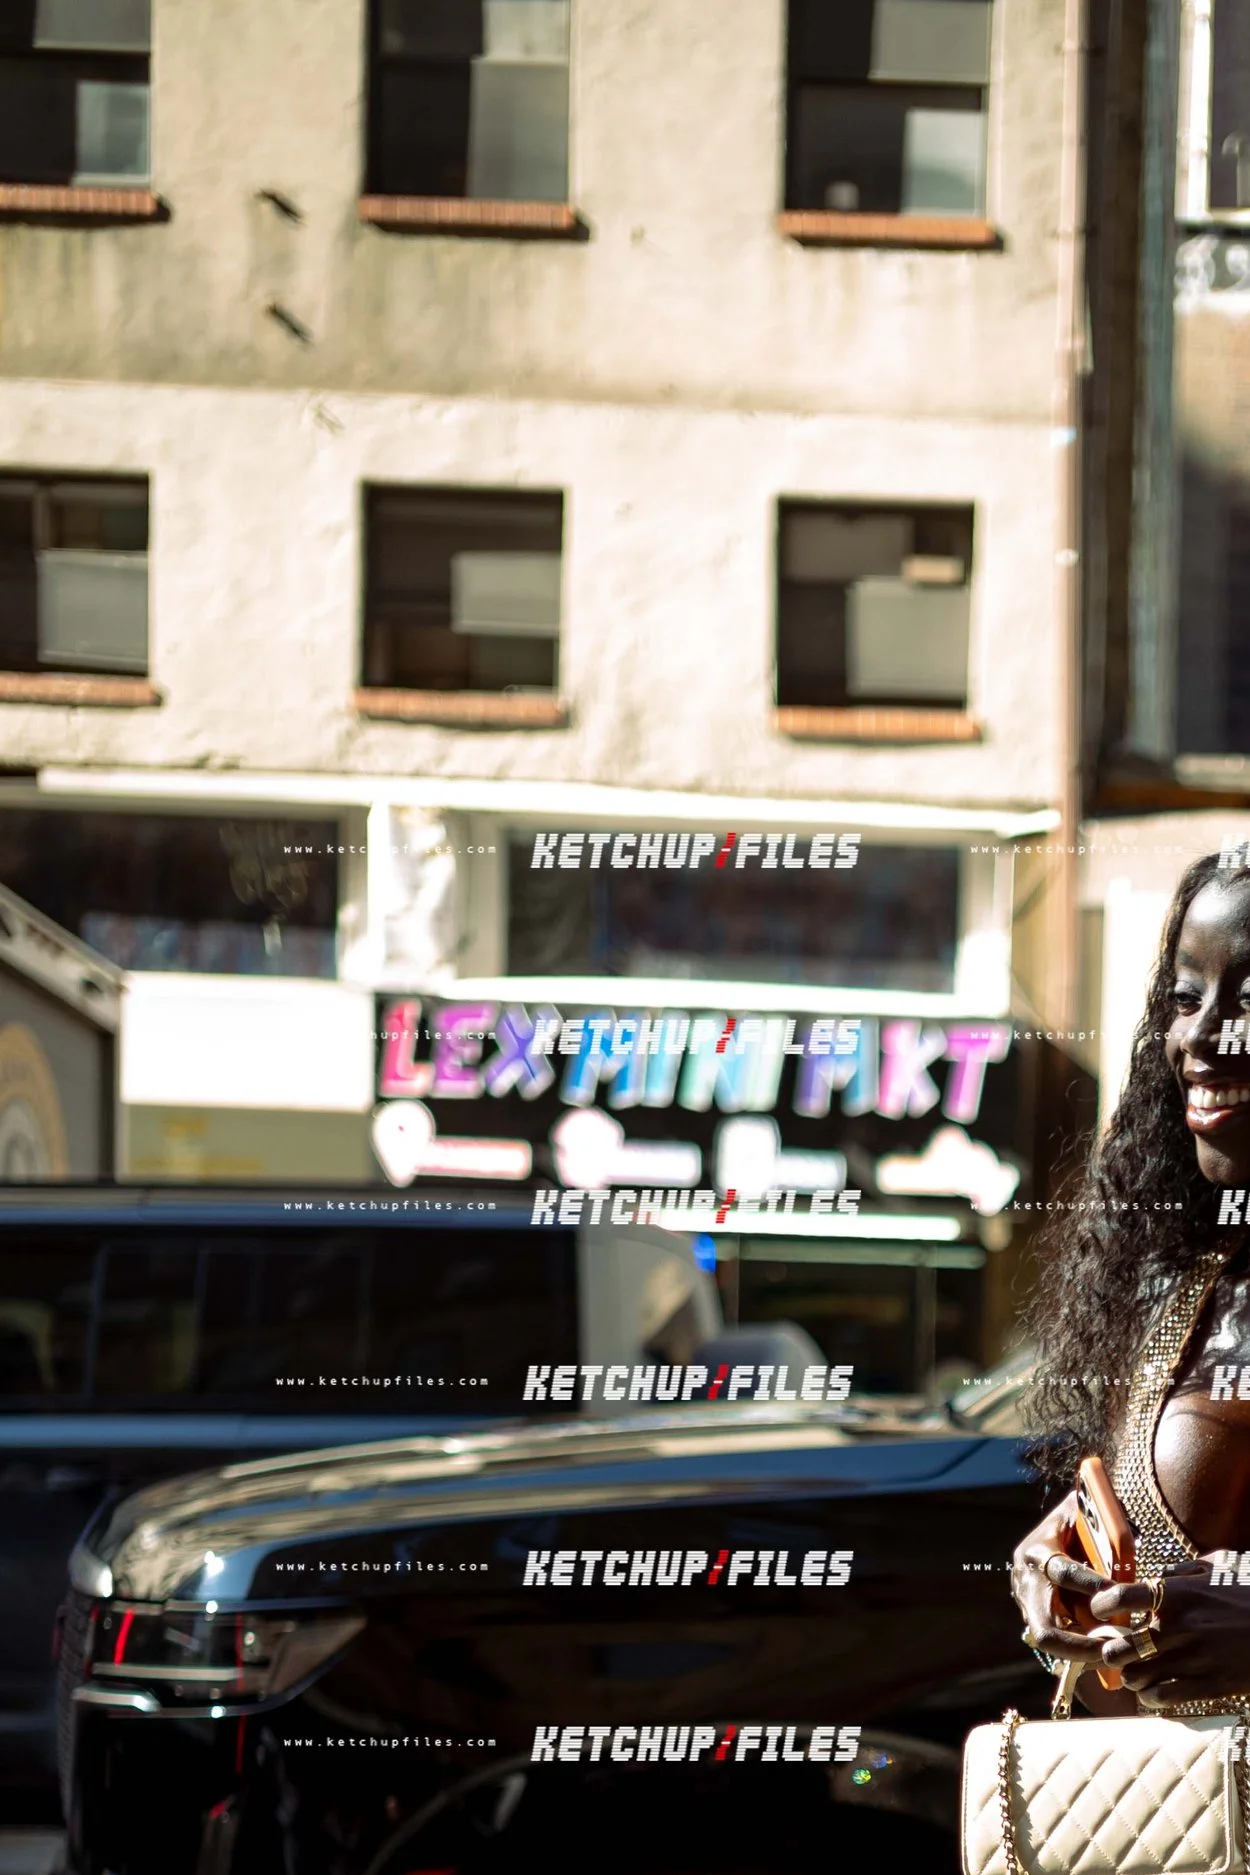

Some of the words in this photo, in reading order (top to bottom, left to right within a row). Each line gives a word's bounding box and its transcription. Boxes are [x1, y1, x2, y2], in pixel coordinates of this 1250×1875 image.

[378, 999, 564, 1098] LEX
[561, 1008, 785, 1112] MINI
[793, 1016, 1012, 1124] MKT
